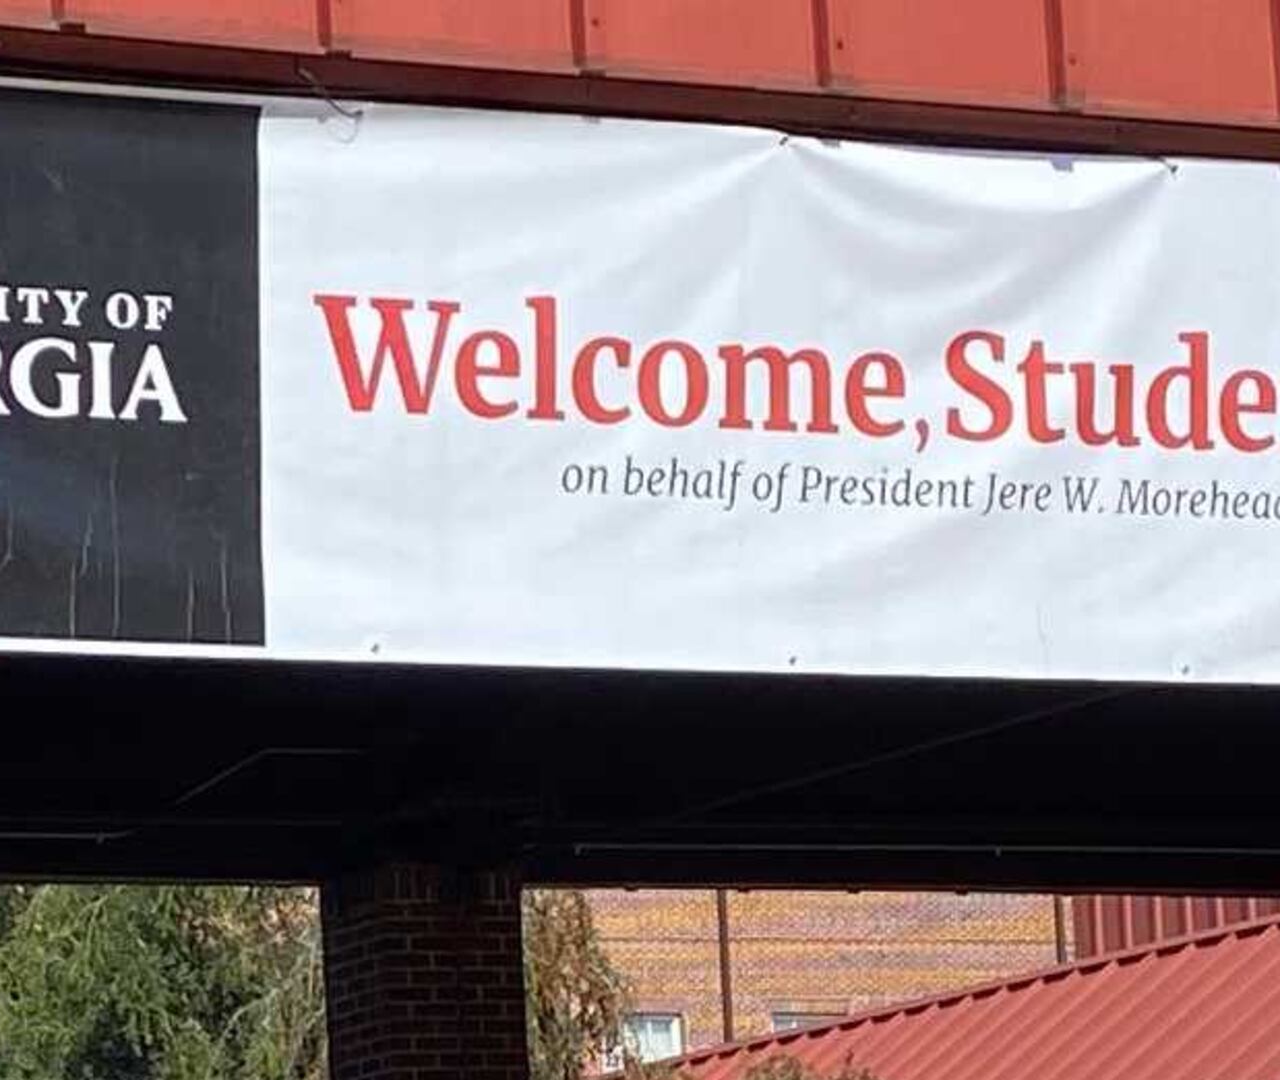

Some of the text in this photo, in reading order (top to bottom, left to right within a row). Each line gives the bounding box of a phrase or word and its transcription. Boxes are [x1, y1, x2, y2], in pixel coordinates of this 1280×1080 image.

[106, 293, 173, 331] OF
[313, 293, 930, 453] Welcome,
[561, 464, 608, 494] on
[623, 457, 744, 512] behalf
[751, 464, 792, 512] of
[800, 466, 974, 510] President
[983, 473, 1053, 515] Jere
[1061, 477, 1105, 513] W.
